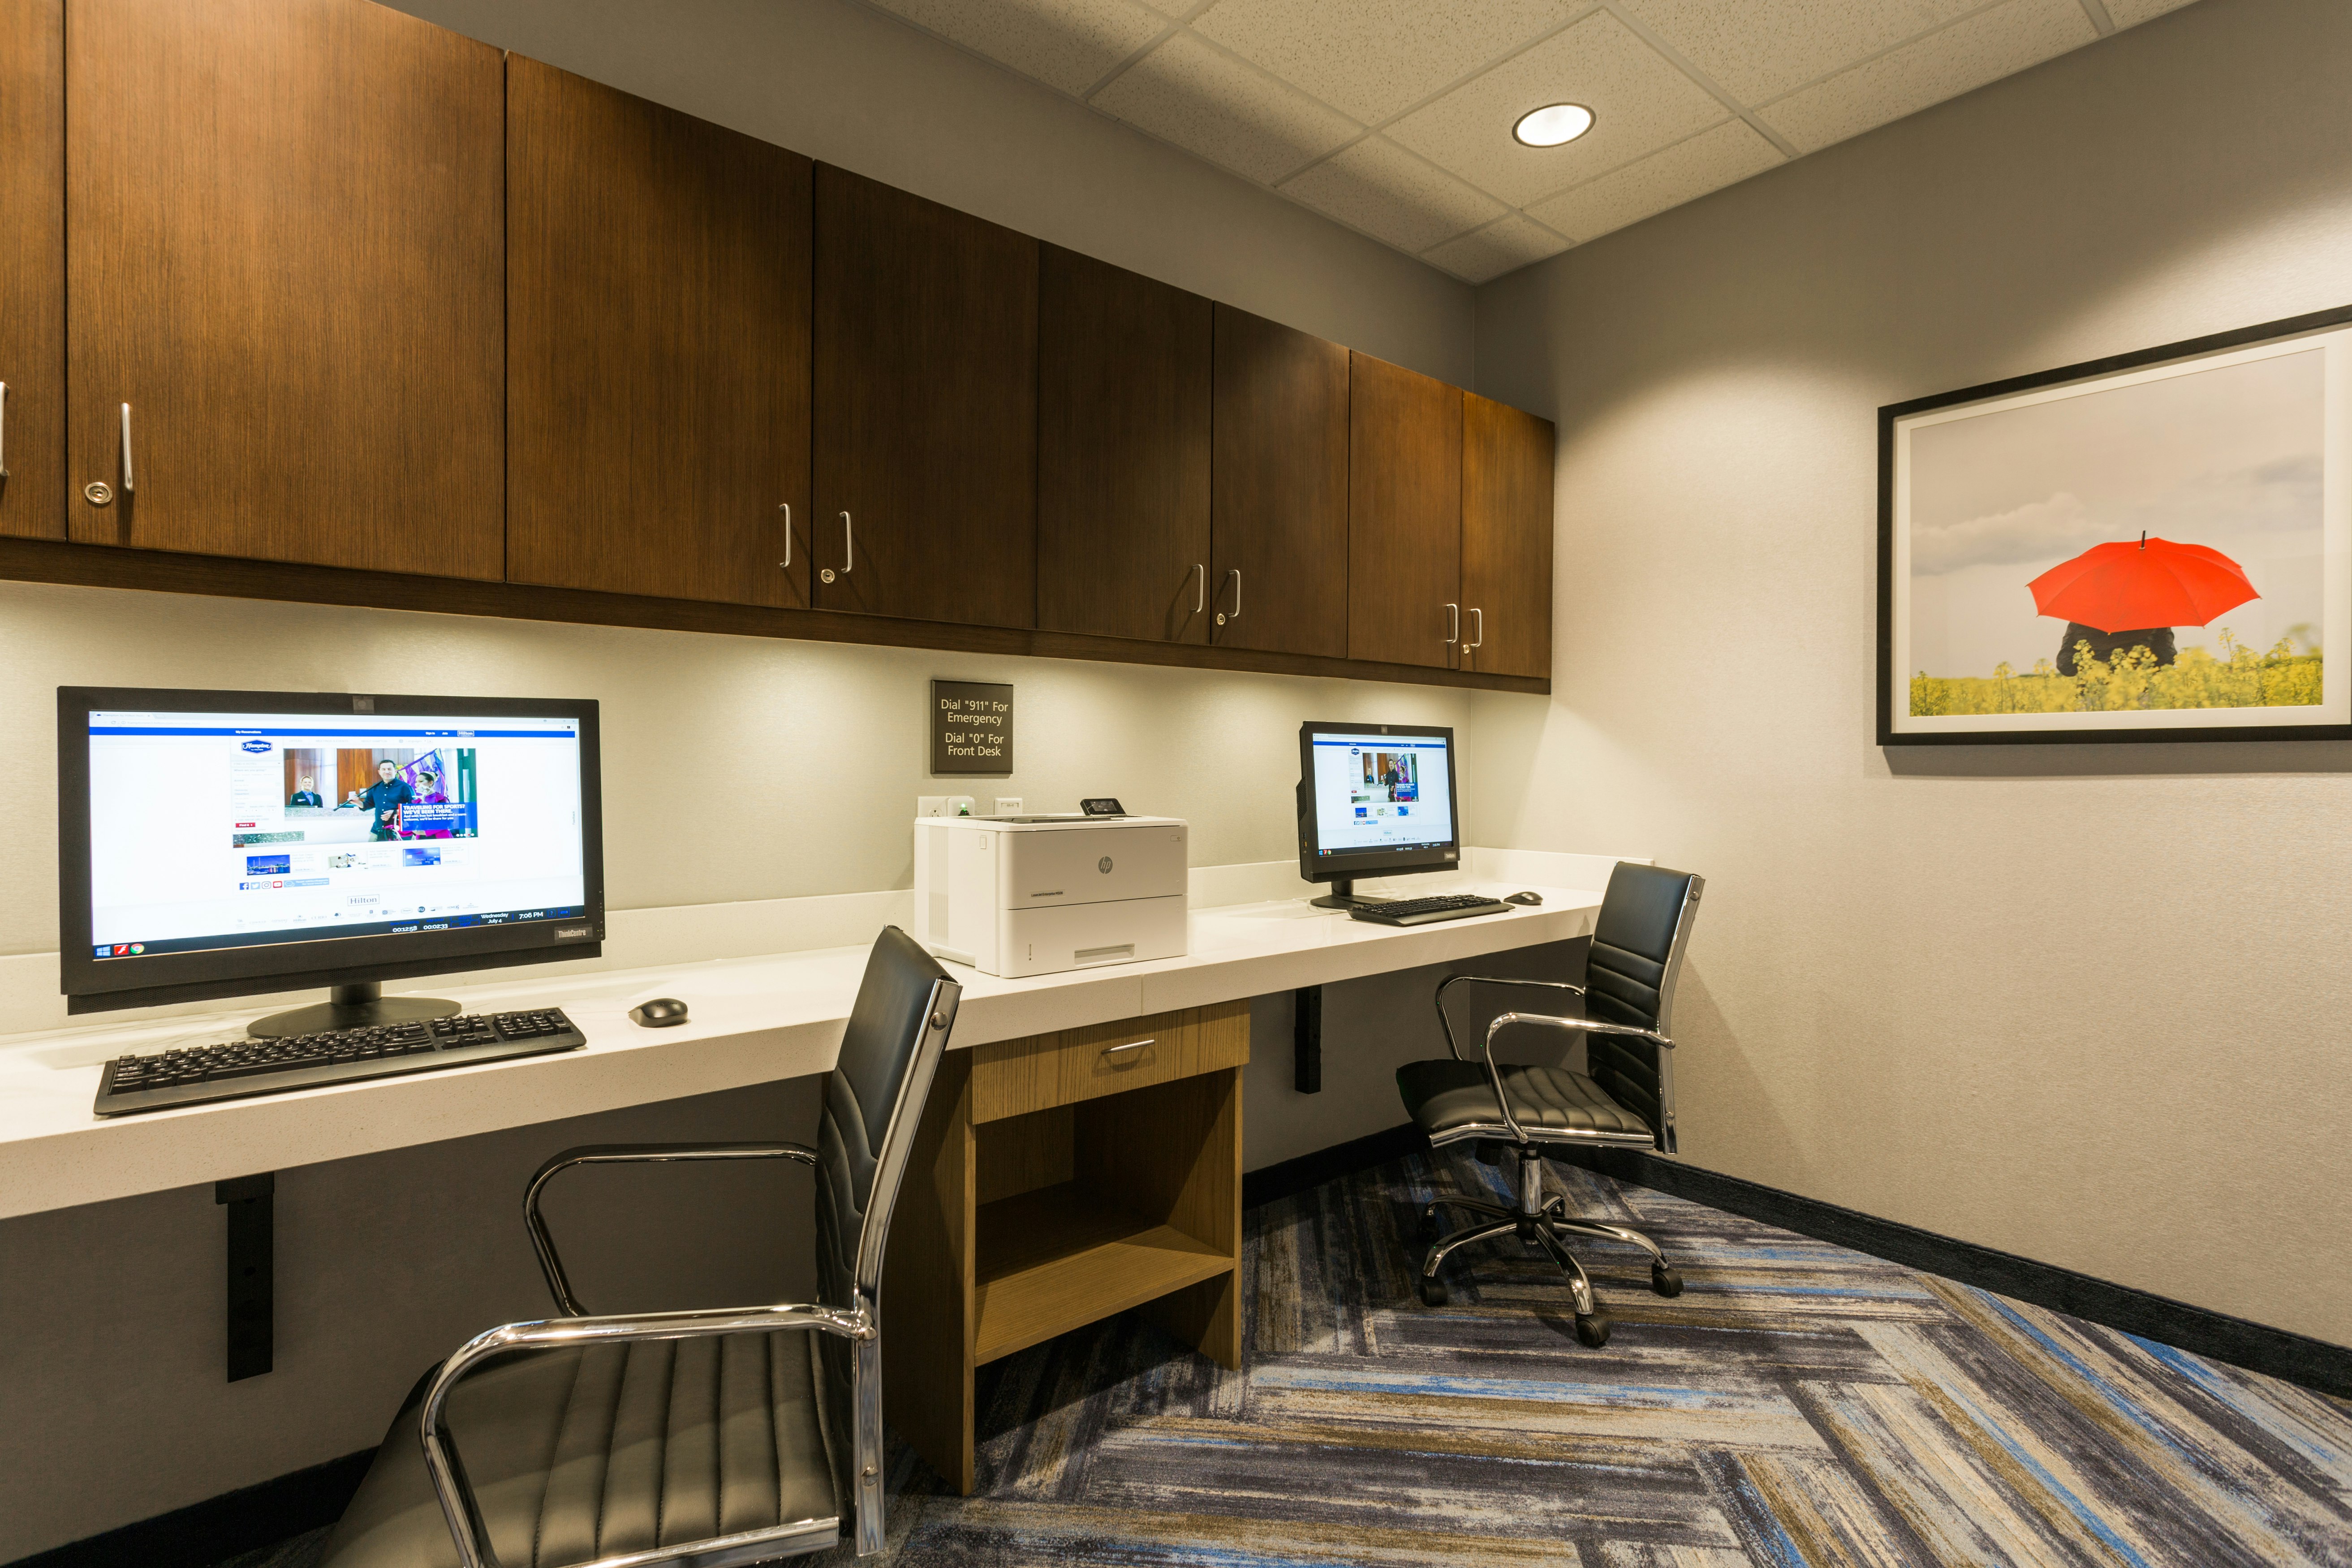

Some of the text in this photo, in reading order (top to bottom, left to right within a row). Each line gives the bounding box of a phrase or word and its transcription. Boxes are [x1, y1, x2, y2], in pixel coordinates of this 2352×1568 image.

[941, 699, 1008, 711] Dial "911" For
[948, 712, 1002, 726] Emergency
[946, 733, 1004, 744] Dial "0" For
[948, 745, 1001, 756] Front Desk
[1100, 856, 1111, 874] hp
[558, 930, 586, 938] ThinkCentre
